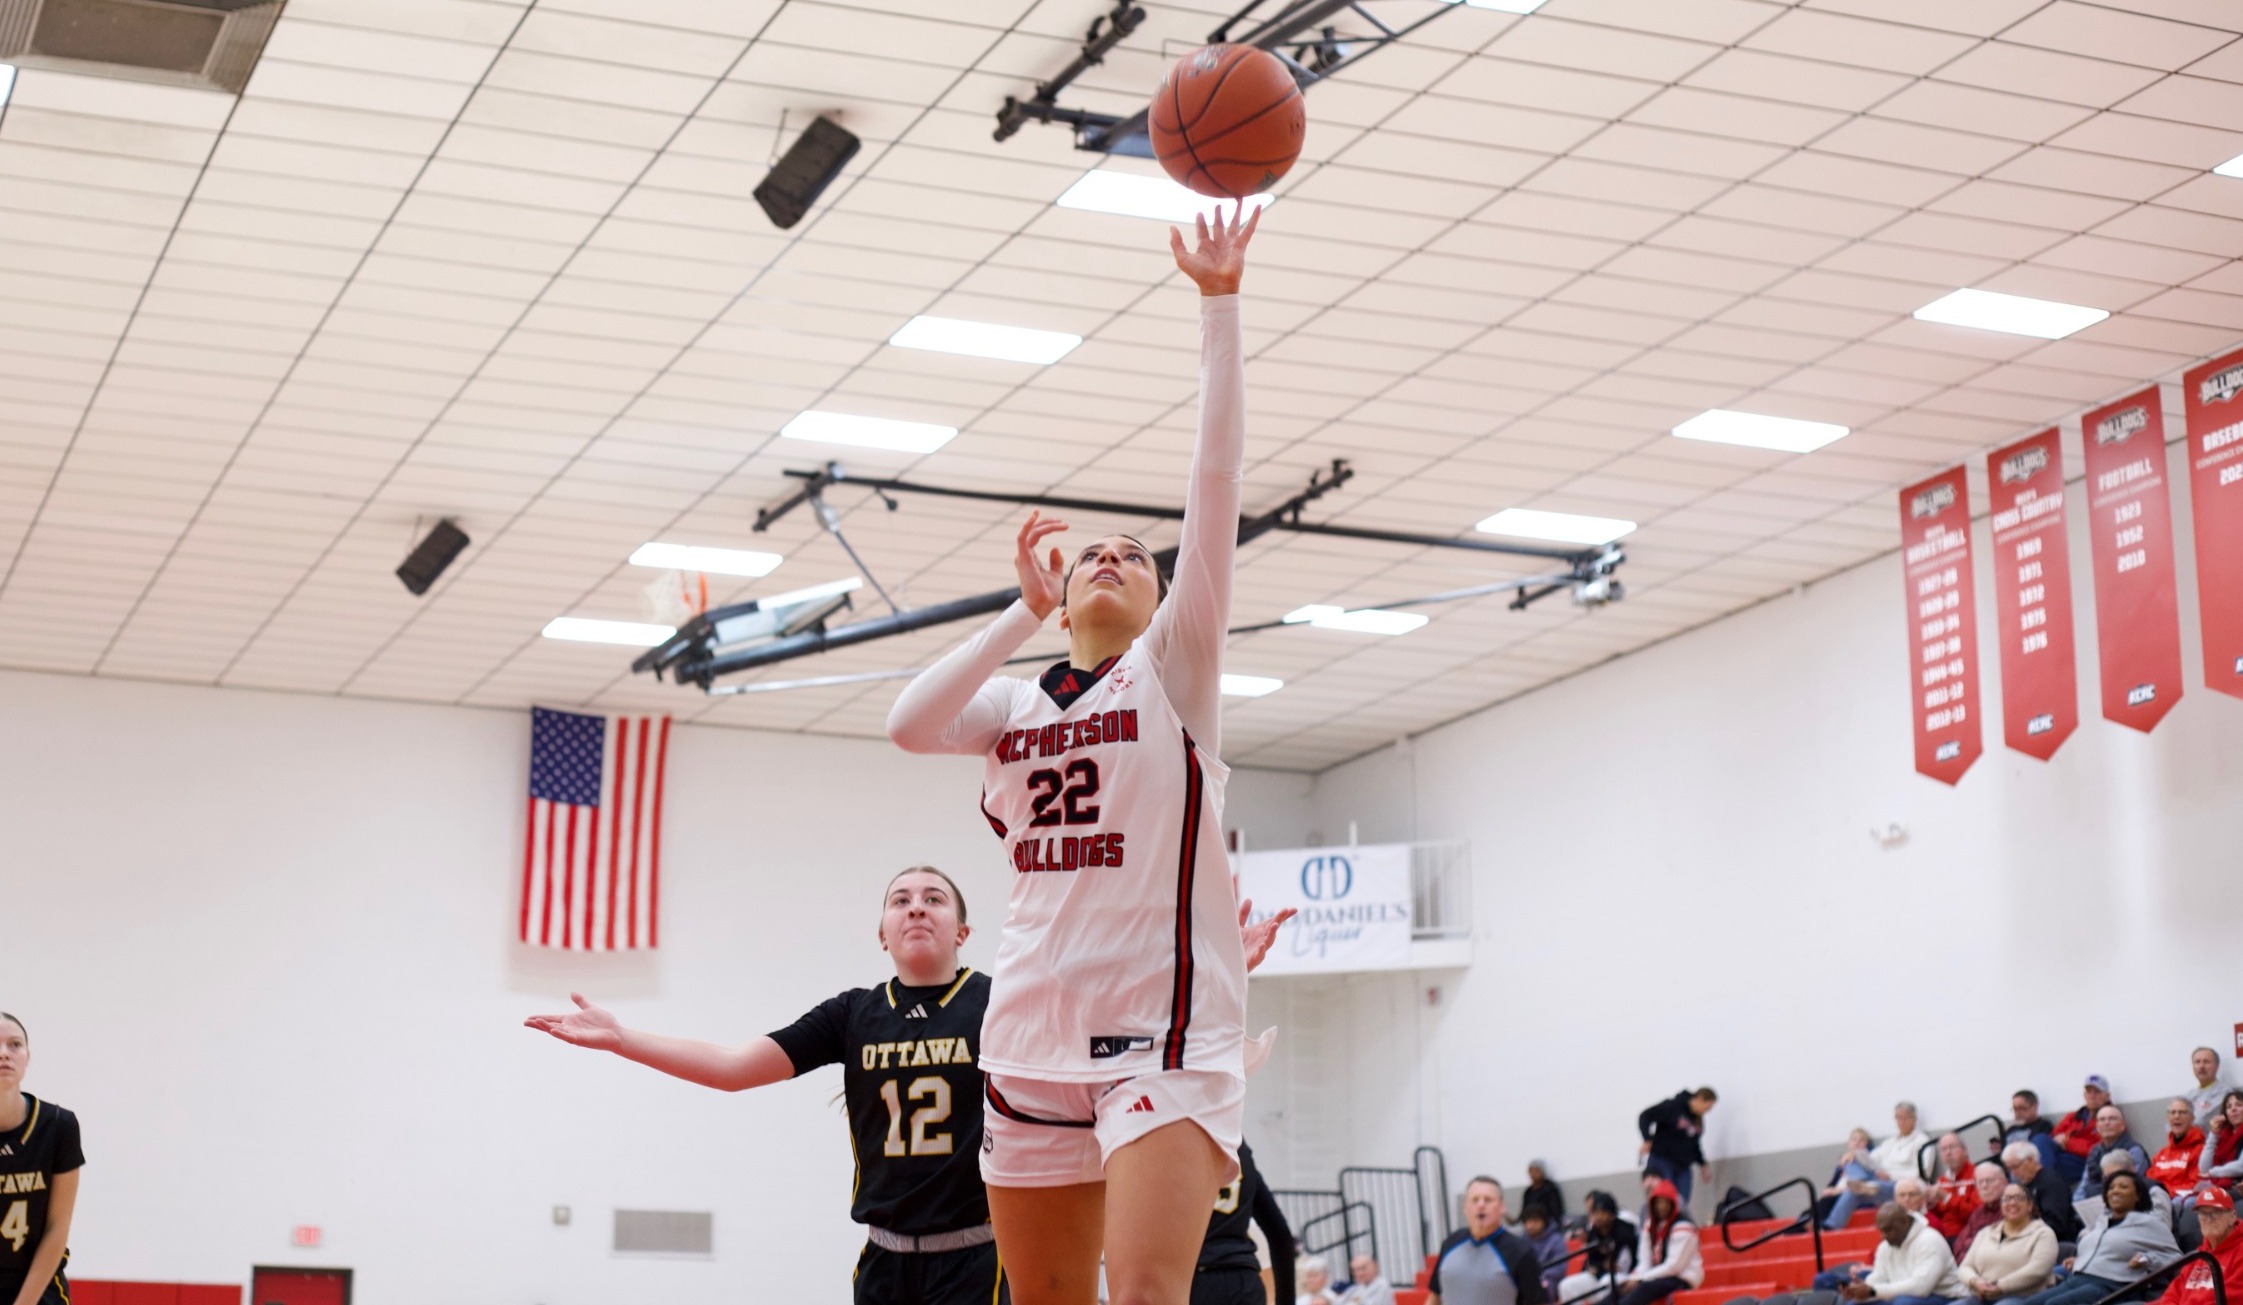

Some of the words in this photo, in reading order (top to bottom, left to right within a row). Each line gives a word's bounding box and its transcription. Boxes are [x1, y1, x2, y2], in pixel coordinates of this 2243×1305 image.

[2096, 407, 2148, 445] BULLDOGS
[2000, 446, 2048, 483] BULLDOGS
[2098, 457, 2153, 492] FOOTBALL
[2021, 491, 2063, 521] COUNTRY
[2114, 500, 2142, 525] 1923
[1907, 528, 1966, 565] BASKETBALL
[2115, 524, 2144, 549] 1952
[2018, 560, 2043, 584] 1971
[2117, 549, 2146, 574] 2010
[2019, 583, 2045, 607] 1972
[996, 709, 1138, 764] MCPHERSON
[1027, 757, 1100, 828] 22
[1304, 902, 1408, 926] DANIEL'S
[862, 1037, 973, 1071] OTTAWA
[880, 1075, 954, 1158] 12
